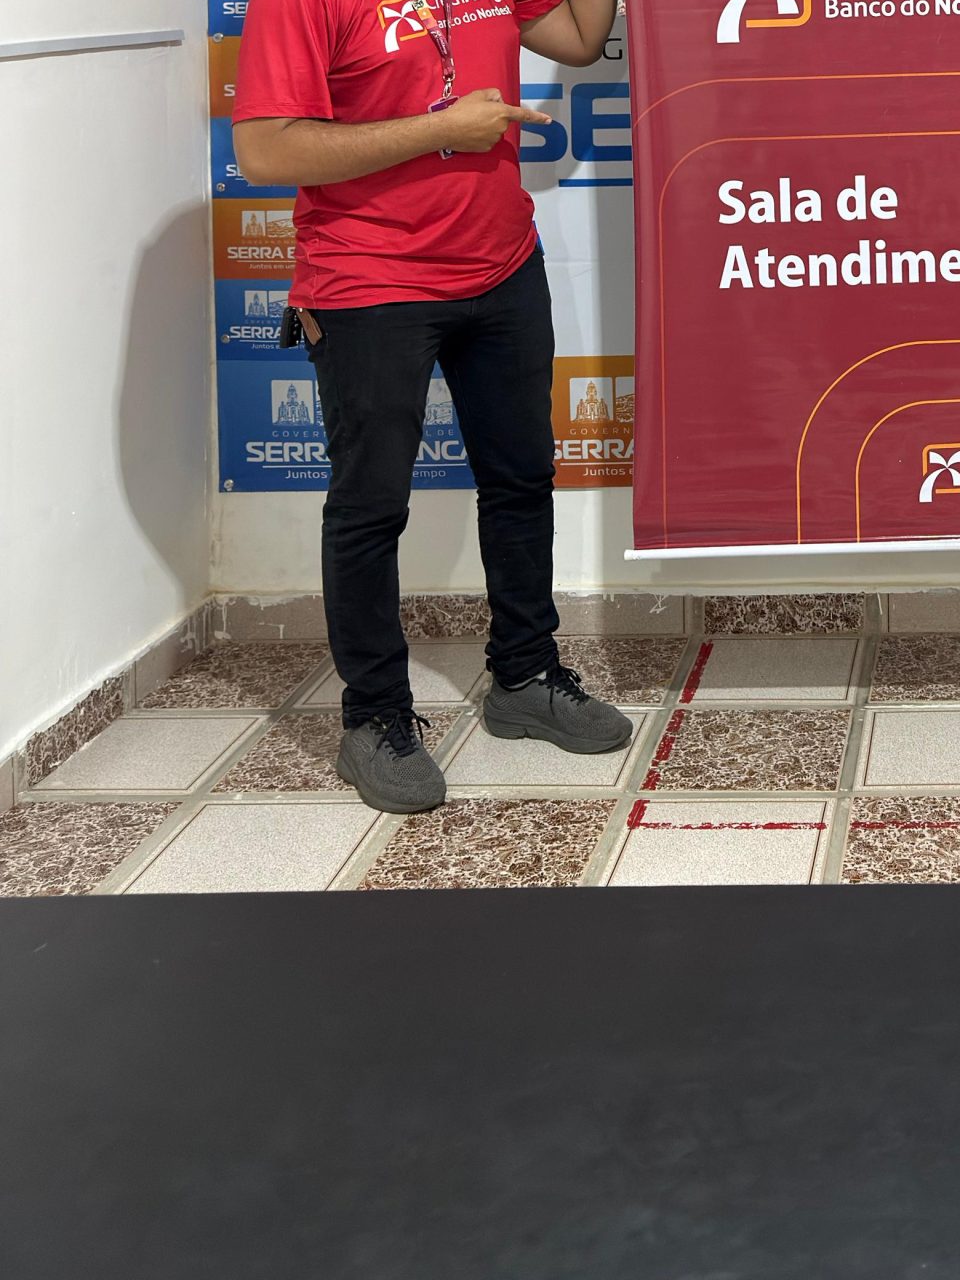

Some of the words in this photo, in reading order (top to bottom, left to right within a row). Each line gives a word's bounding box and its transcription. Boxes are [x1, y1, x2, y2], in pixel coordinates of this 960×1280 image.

[463, 12, 477, 23] do
[717, 177, 823, 225] Sala
[836, 174, 899, 221] de
[227, 247, 284, 259] SERRA
[570, 427, 630, 435] GOVERN
[286, 470, 328, 479] Juntos
[412, 469, 446, 478] empo
[584, 467, 625, 476] Juntos
